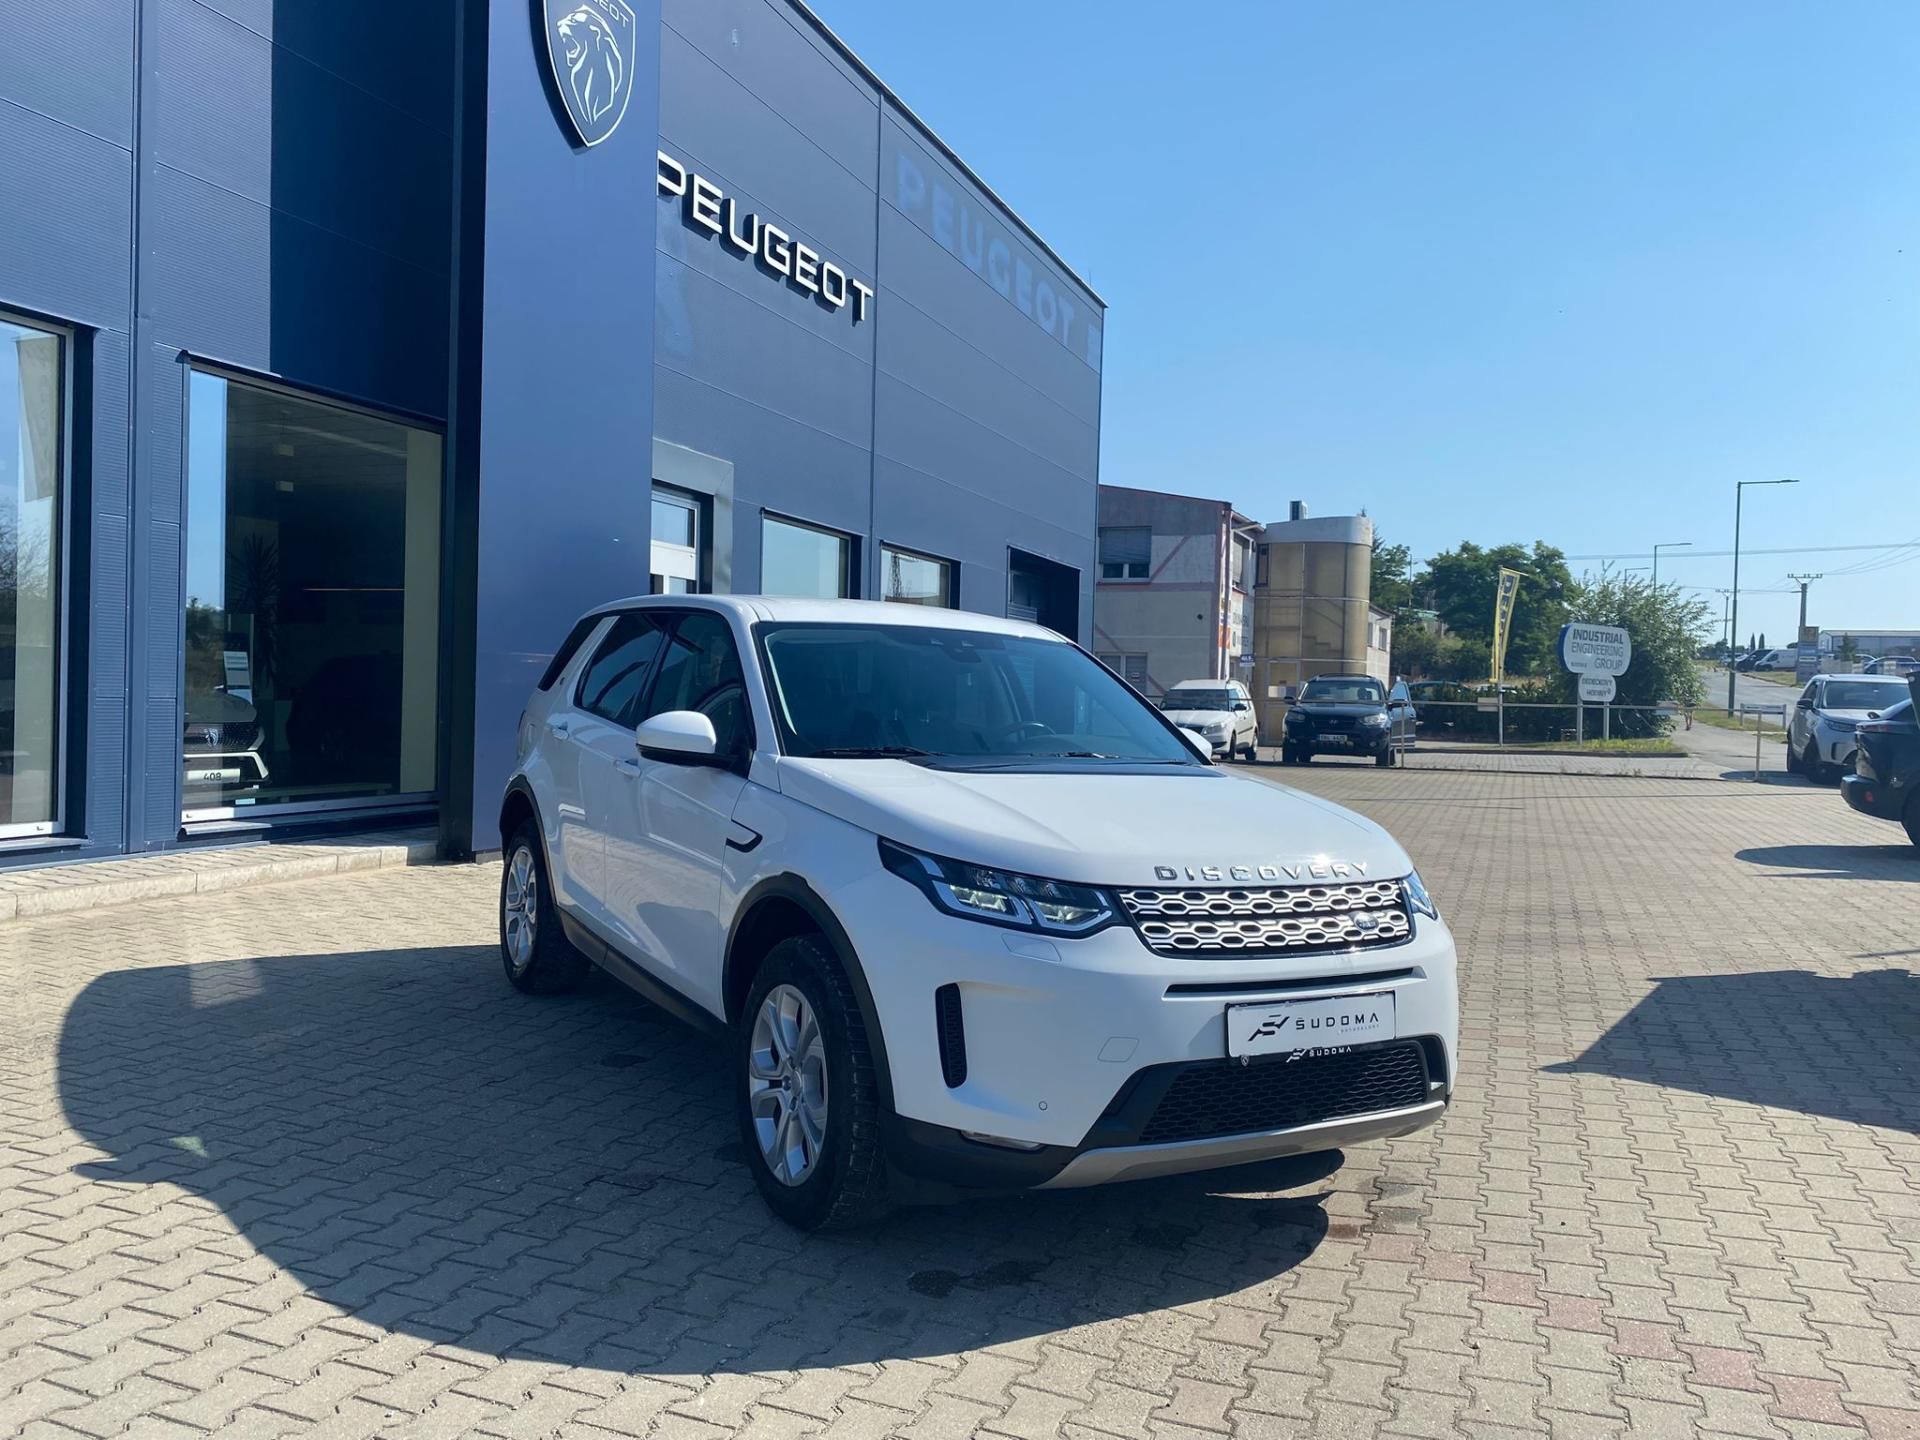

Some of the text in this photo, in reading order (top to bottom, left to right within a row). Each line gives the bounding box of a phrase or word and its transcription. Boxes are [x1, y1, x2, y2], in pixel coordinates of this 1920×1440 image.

[657, 150, 874, 321] PEUGEOT
[1573, 629, 1624, 645] INDUSTRIAL
[1571, 641, 1624, 657] ENGINEERING
[1594, 657, 1623, 670] GROUP
[203, 772, 222, 781] 408
[1153, 862, 1368, 882] DISCOVERY
